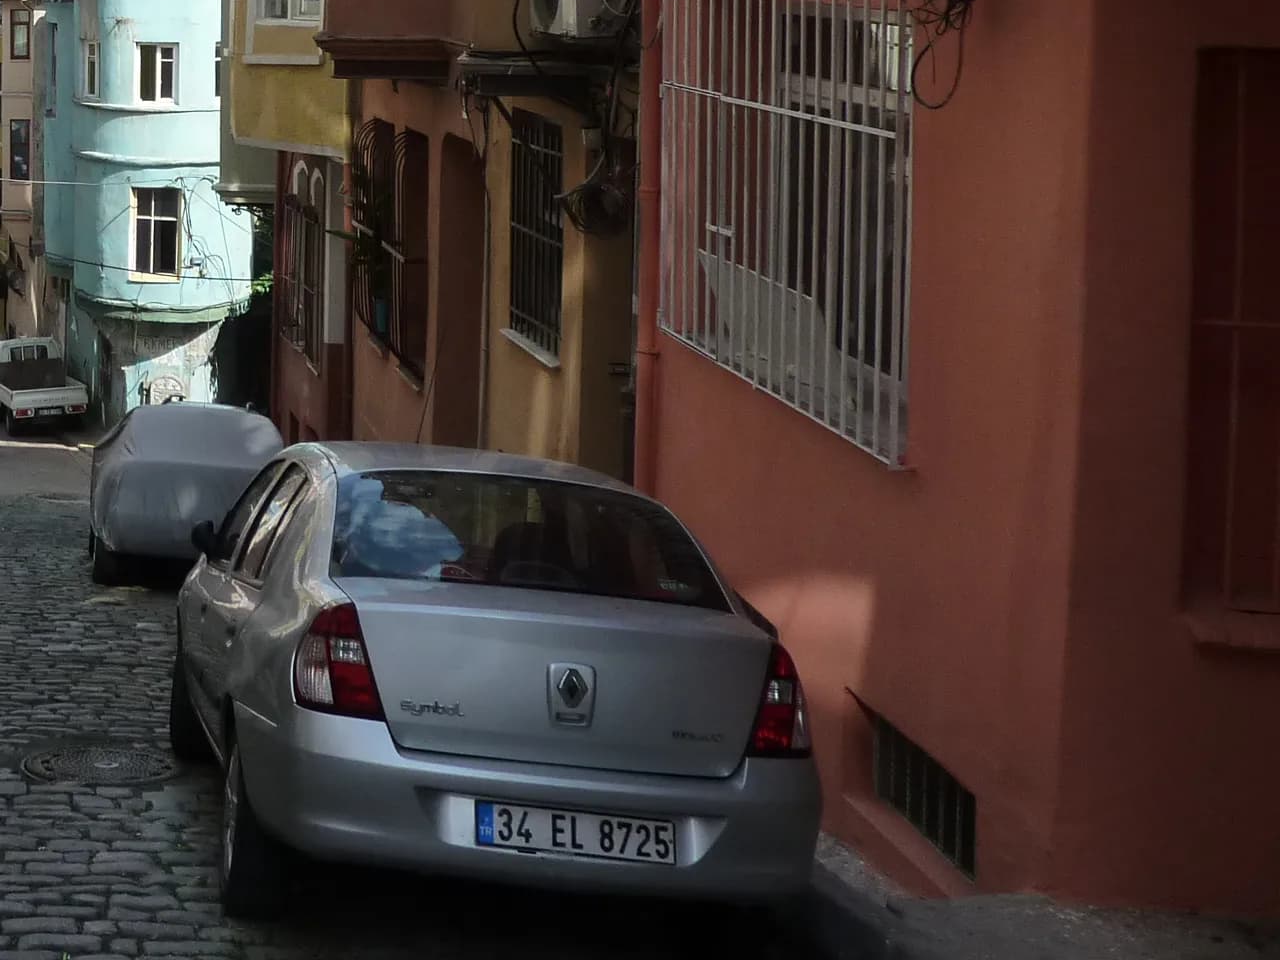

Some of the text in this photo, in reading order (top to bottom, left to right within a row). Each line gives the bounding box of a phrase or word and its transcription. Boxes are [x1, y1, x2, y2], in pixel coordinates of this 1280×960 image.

[400, 699, 465, 717] Symbol
[479, 825, 493, 836] TR
[497, 807, 671, 860] 34 EL 8725
